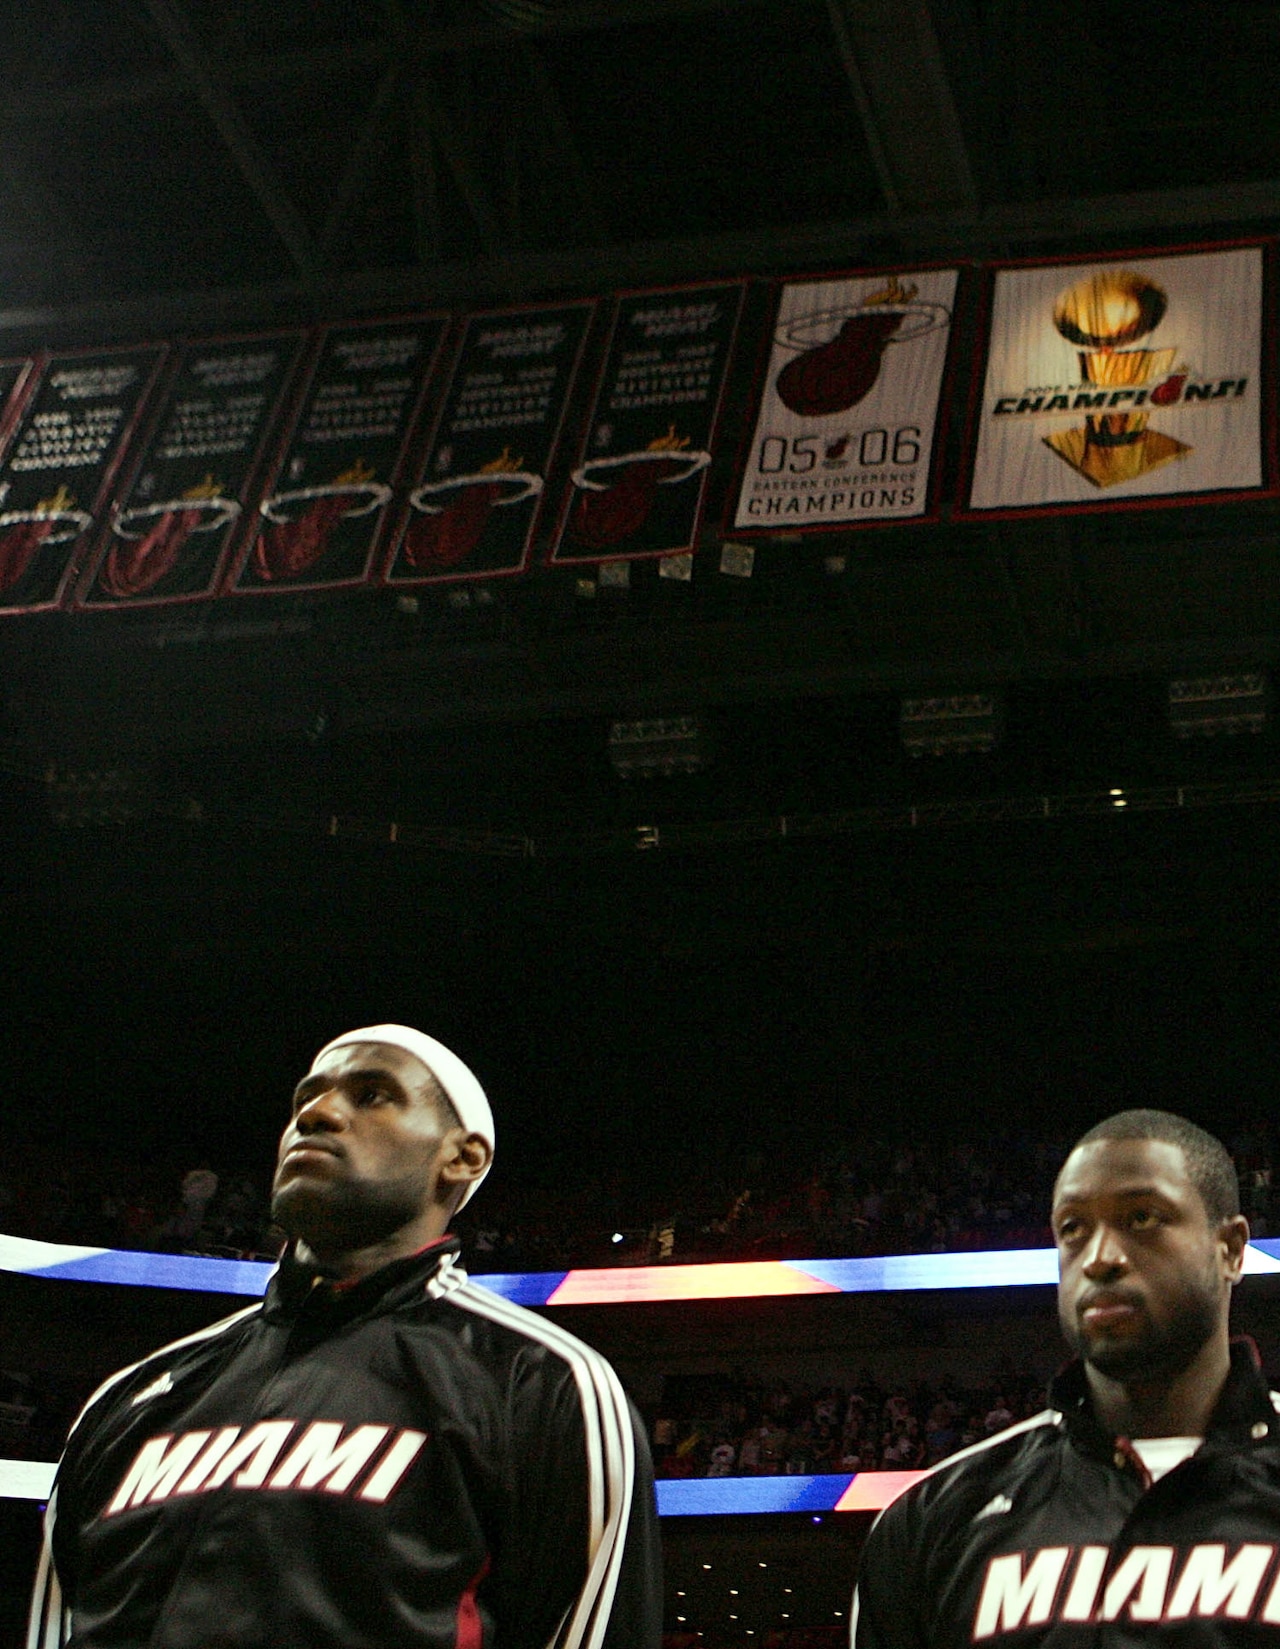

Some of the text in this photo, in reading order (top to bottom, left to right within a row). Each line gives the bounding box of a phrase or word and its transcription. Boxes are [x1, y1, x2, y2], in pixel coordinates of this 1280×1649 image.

[758, 426, 921, 474] 05 06
[748, 487, 915, 515] CHAMPIONS
[753, 472, 916, 492] EASTERN CONFERENCE
[104, 1418, 429, 1518] MIAMI
